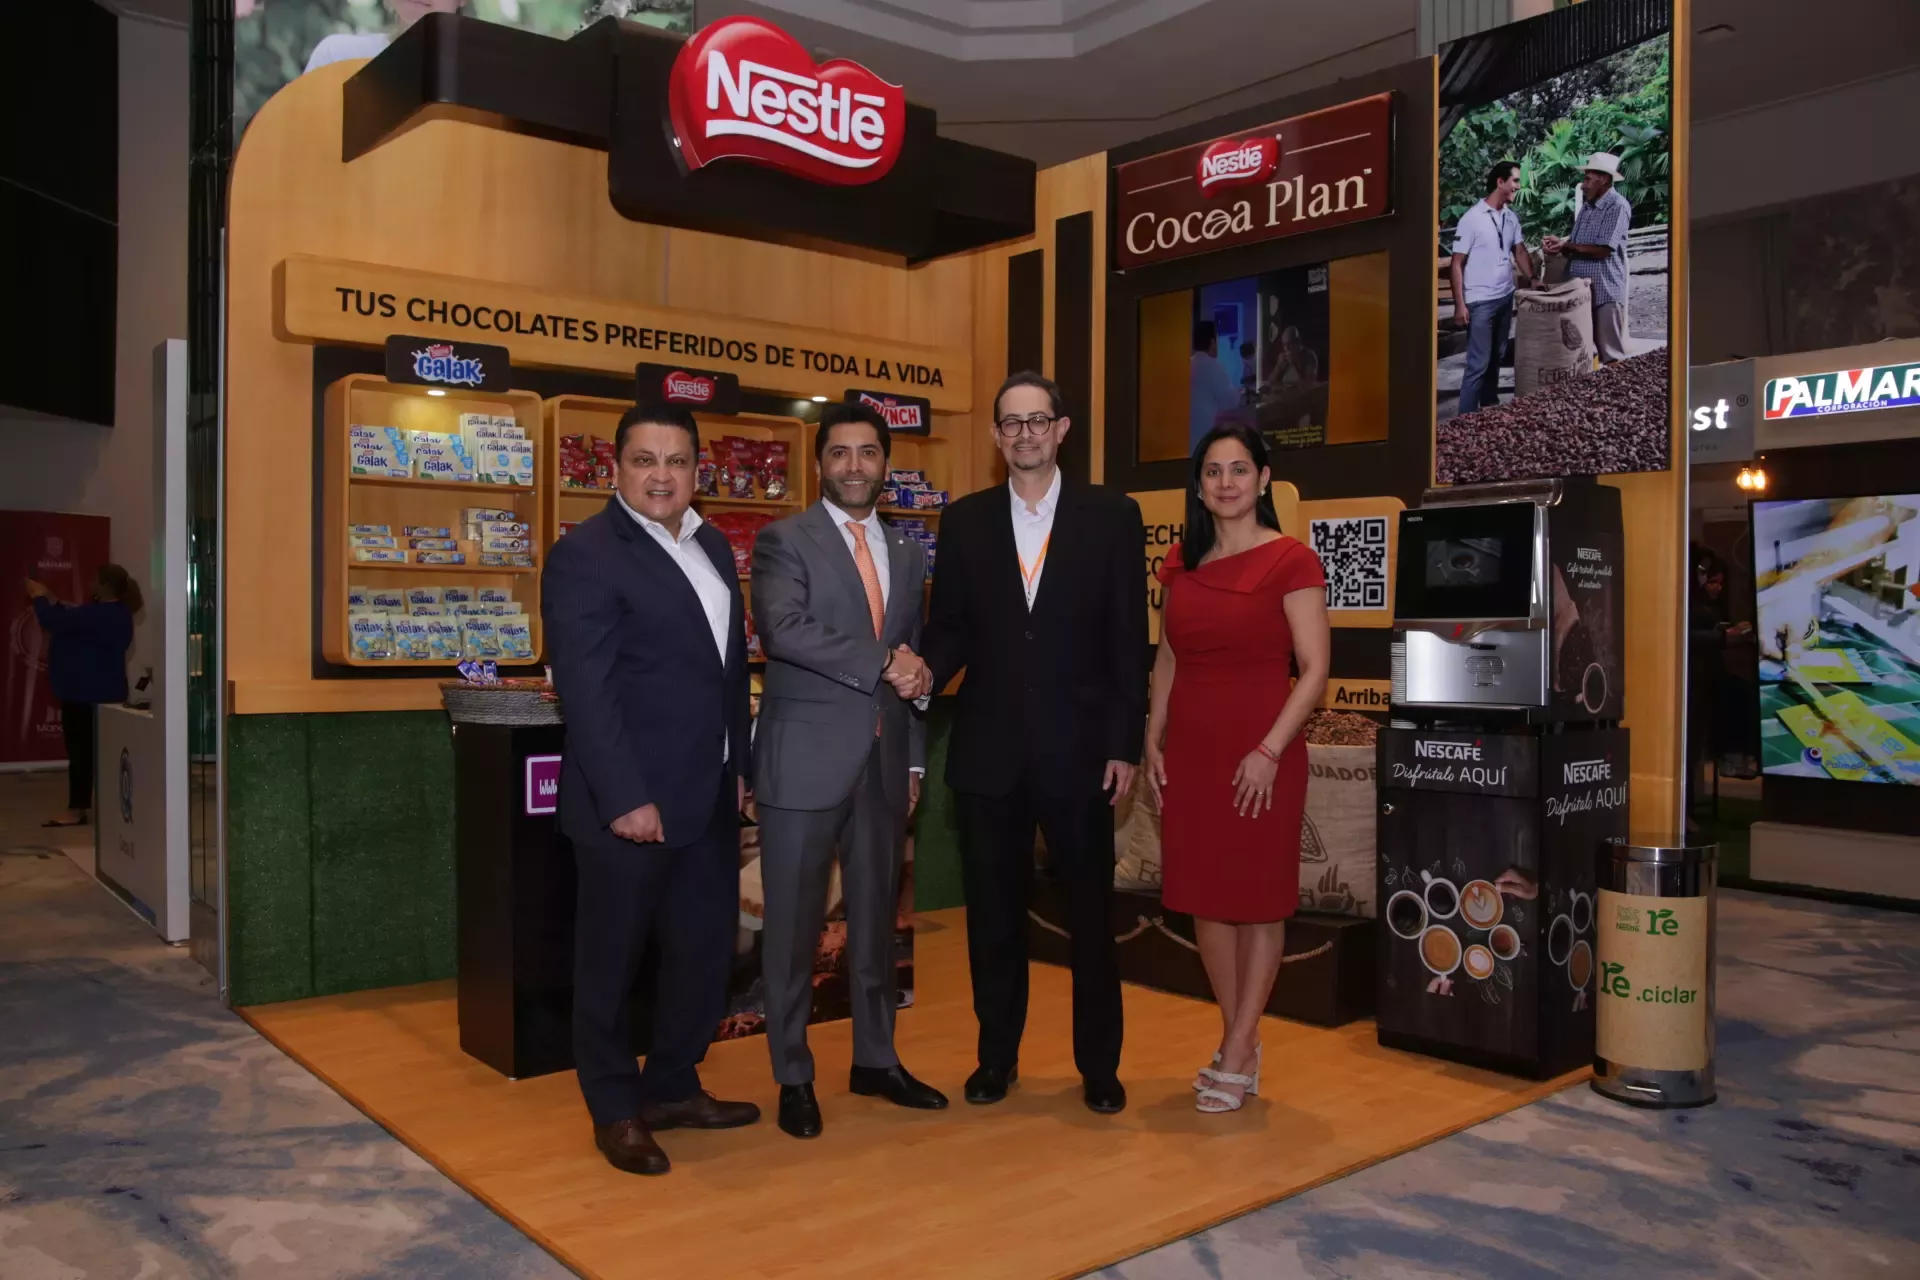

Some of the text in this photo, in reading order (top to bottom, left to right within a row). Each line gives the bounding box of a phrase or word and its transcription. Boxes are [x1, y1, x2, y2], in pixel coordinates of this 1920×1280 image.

[706, 50, 886, 151] Nestlé
[1202, 146, 1263, 178] Nestlé
[1126, 200, 1254, 255] Cocoa
[335, 287, 944, 387] TUS CHOCOLATES PREFERIDOS DE TODA LA VIDA
[418, 355, 482, 382] Galak
[668, 379, 710, 397] Nestlé
[1690, 398, 1730, 432] st
[1817, 400, 1888, 413] CORPORACIÓN
[358, 455, 388, 467] Galak
[424, 460, 454, 472] Galak
[355, 623, 385, 633] Galak
[396, 624, 425, 634] Galak
[466, 622, 494, 632] Galak
[500, 626, 526, 636] Galak
[1335, 686, 1390, 705] Arriba
[1414, 738, 1483, 761] NESCAFÉ
[1392, 763, 1508, 788] Disfrútalo AQUÍ
[1595, 781, 1627, 810] AQUÍ
